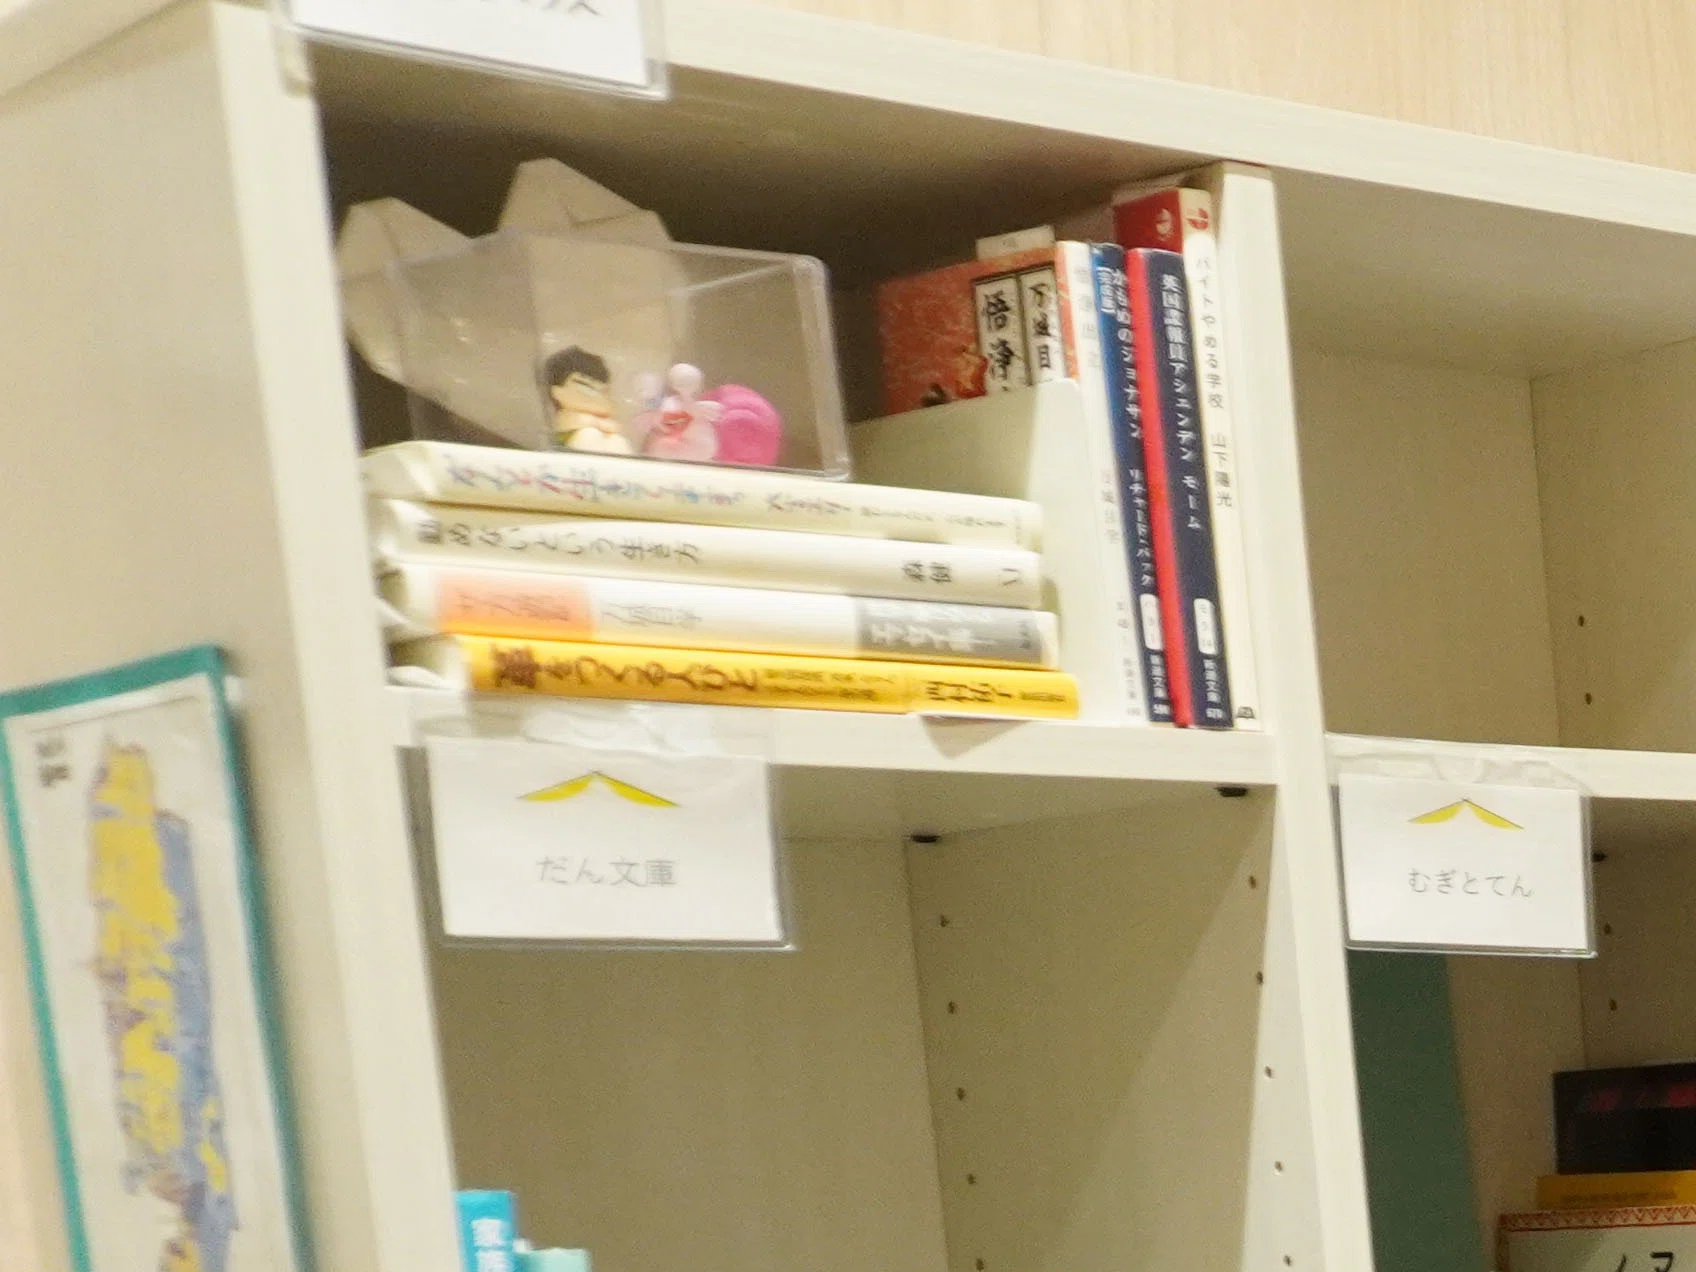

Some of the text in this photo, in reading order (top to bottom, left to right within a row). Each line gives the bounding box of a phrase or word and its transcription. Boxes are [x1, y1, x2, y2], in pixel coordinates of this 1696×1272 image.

[1182, 475, 1201, 530] モーム
[538, 855, 678, 890] だん文庫
[1408, 867, 1536, 899] むぎとてん
